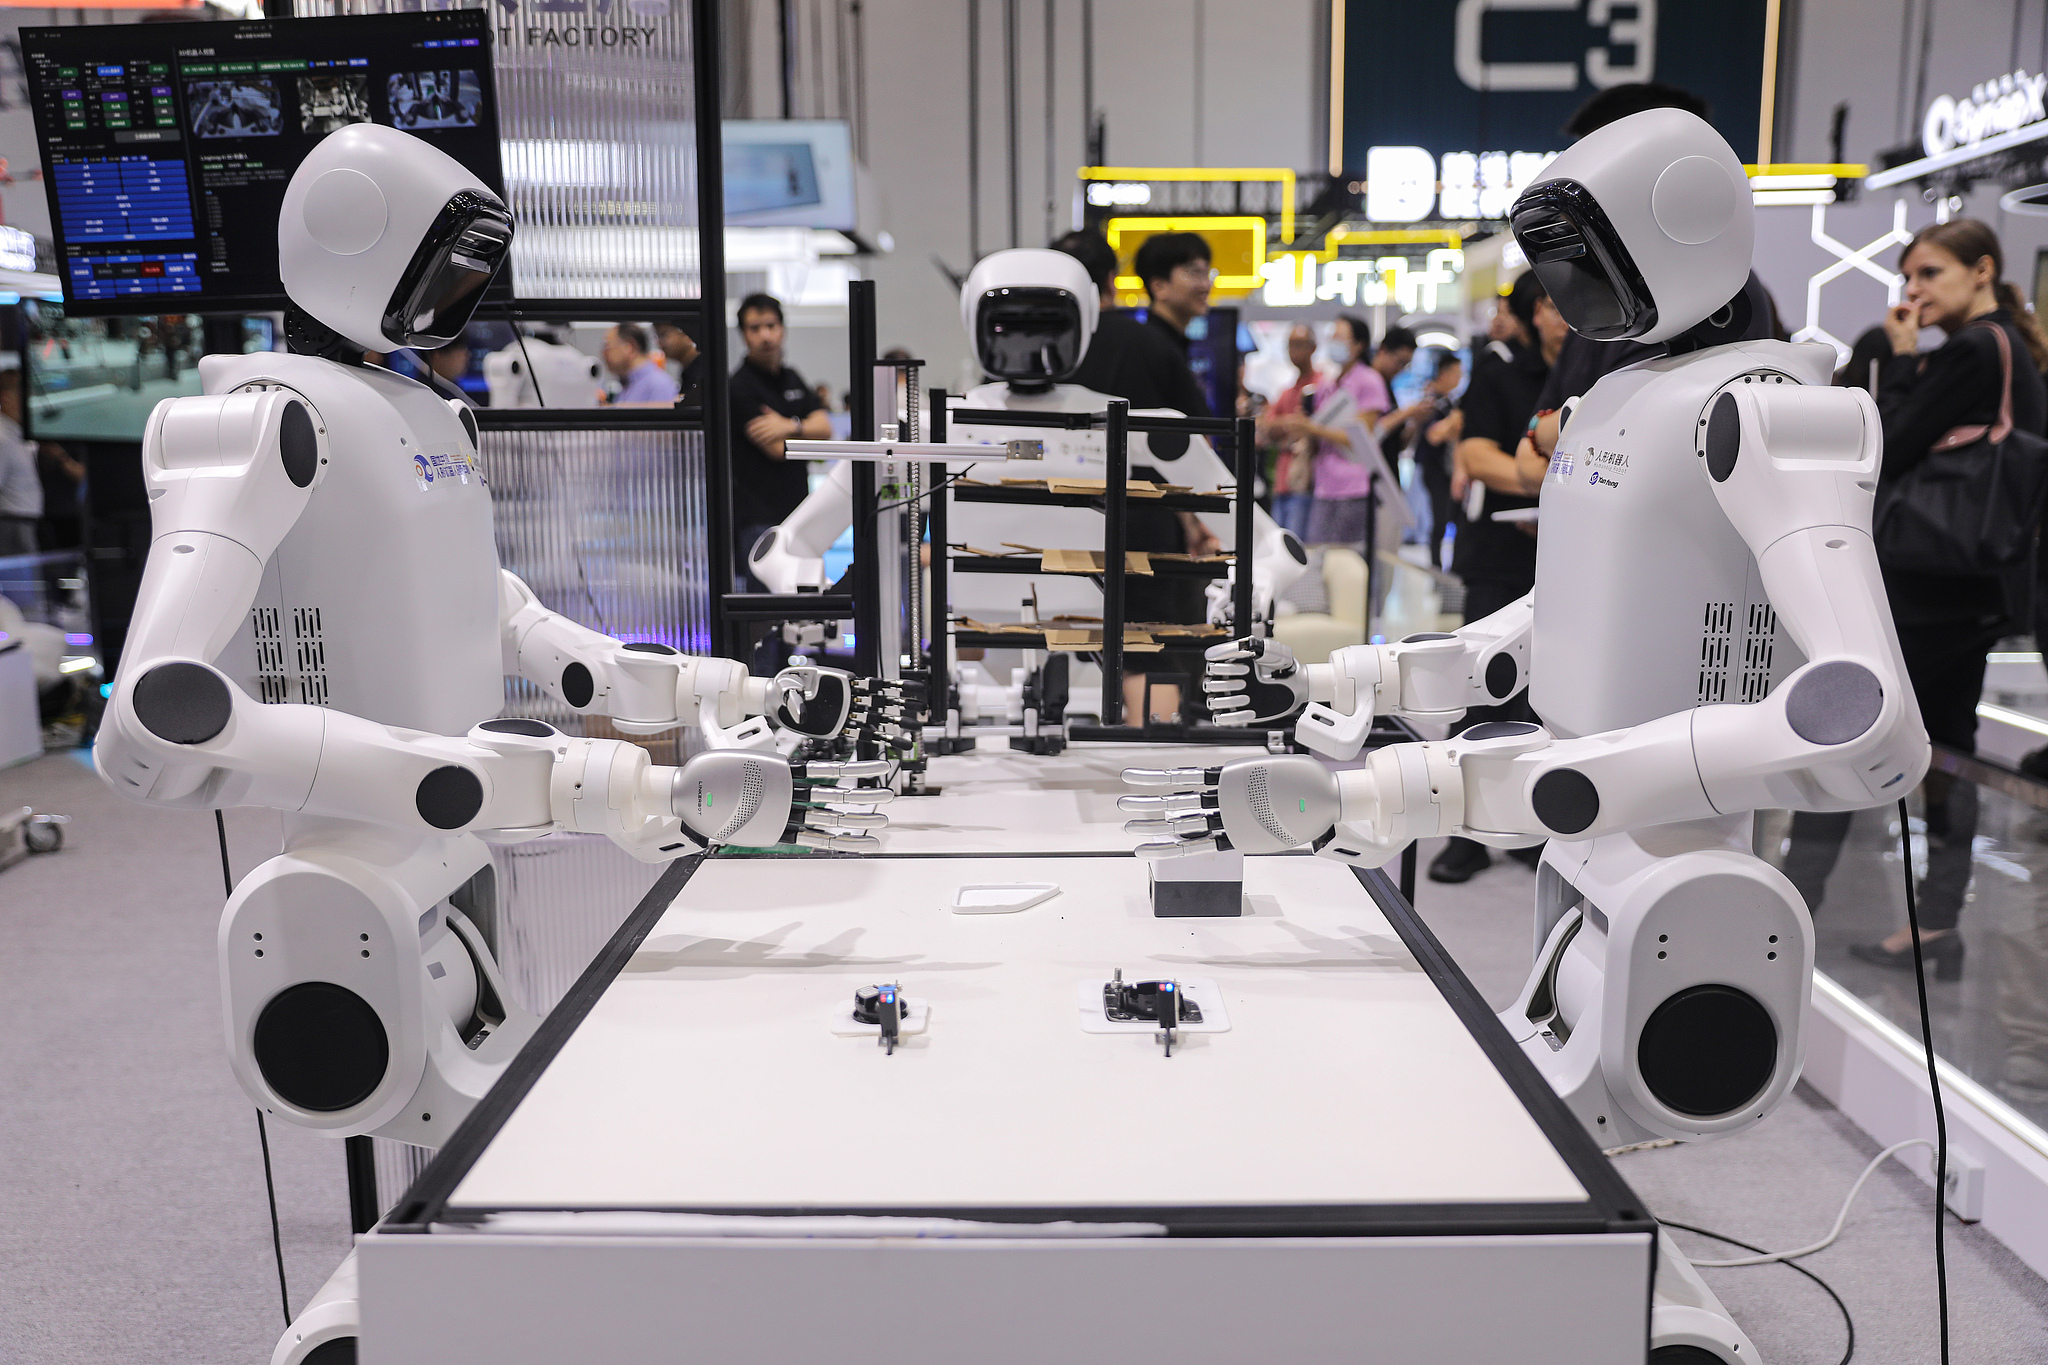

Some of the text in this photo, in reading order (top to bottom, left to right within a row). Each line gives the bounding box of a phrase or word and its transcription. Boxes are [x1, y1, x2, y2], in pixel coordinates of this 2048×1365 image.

[528, 26, 656, 47] FACTORY
[1454, 0, 1658, 92] C3
[1595, 449, 1630, 468] 人形机器人
